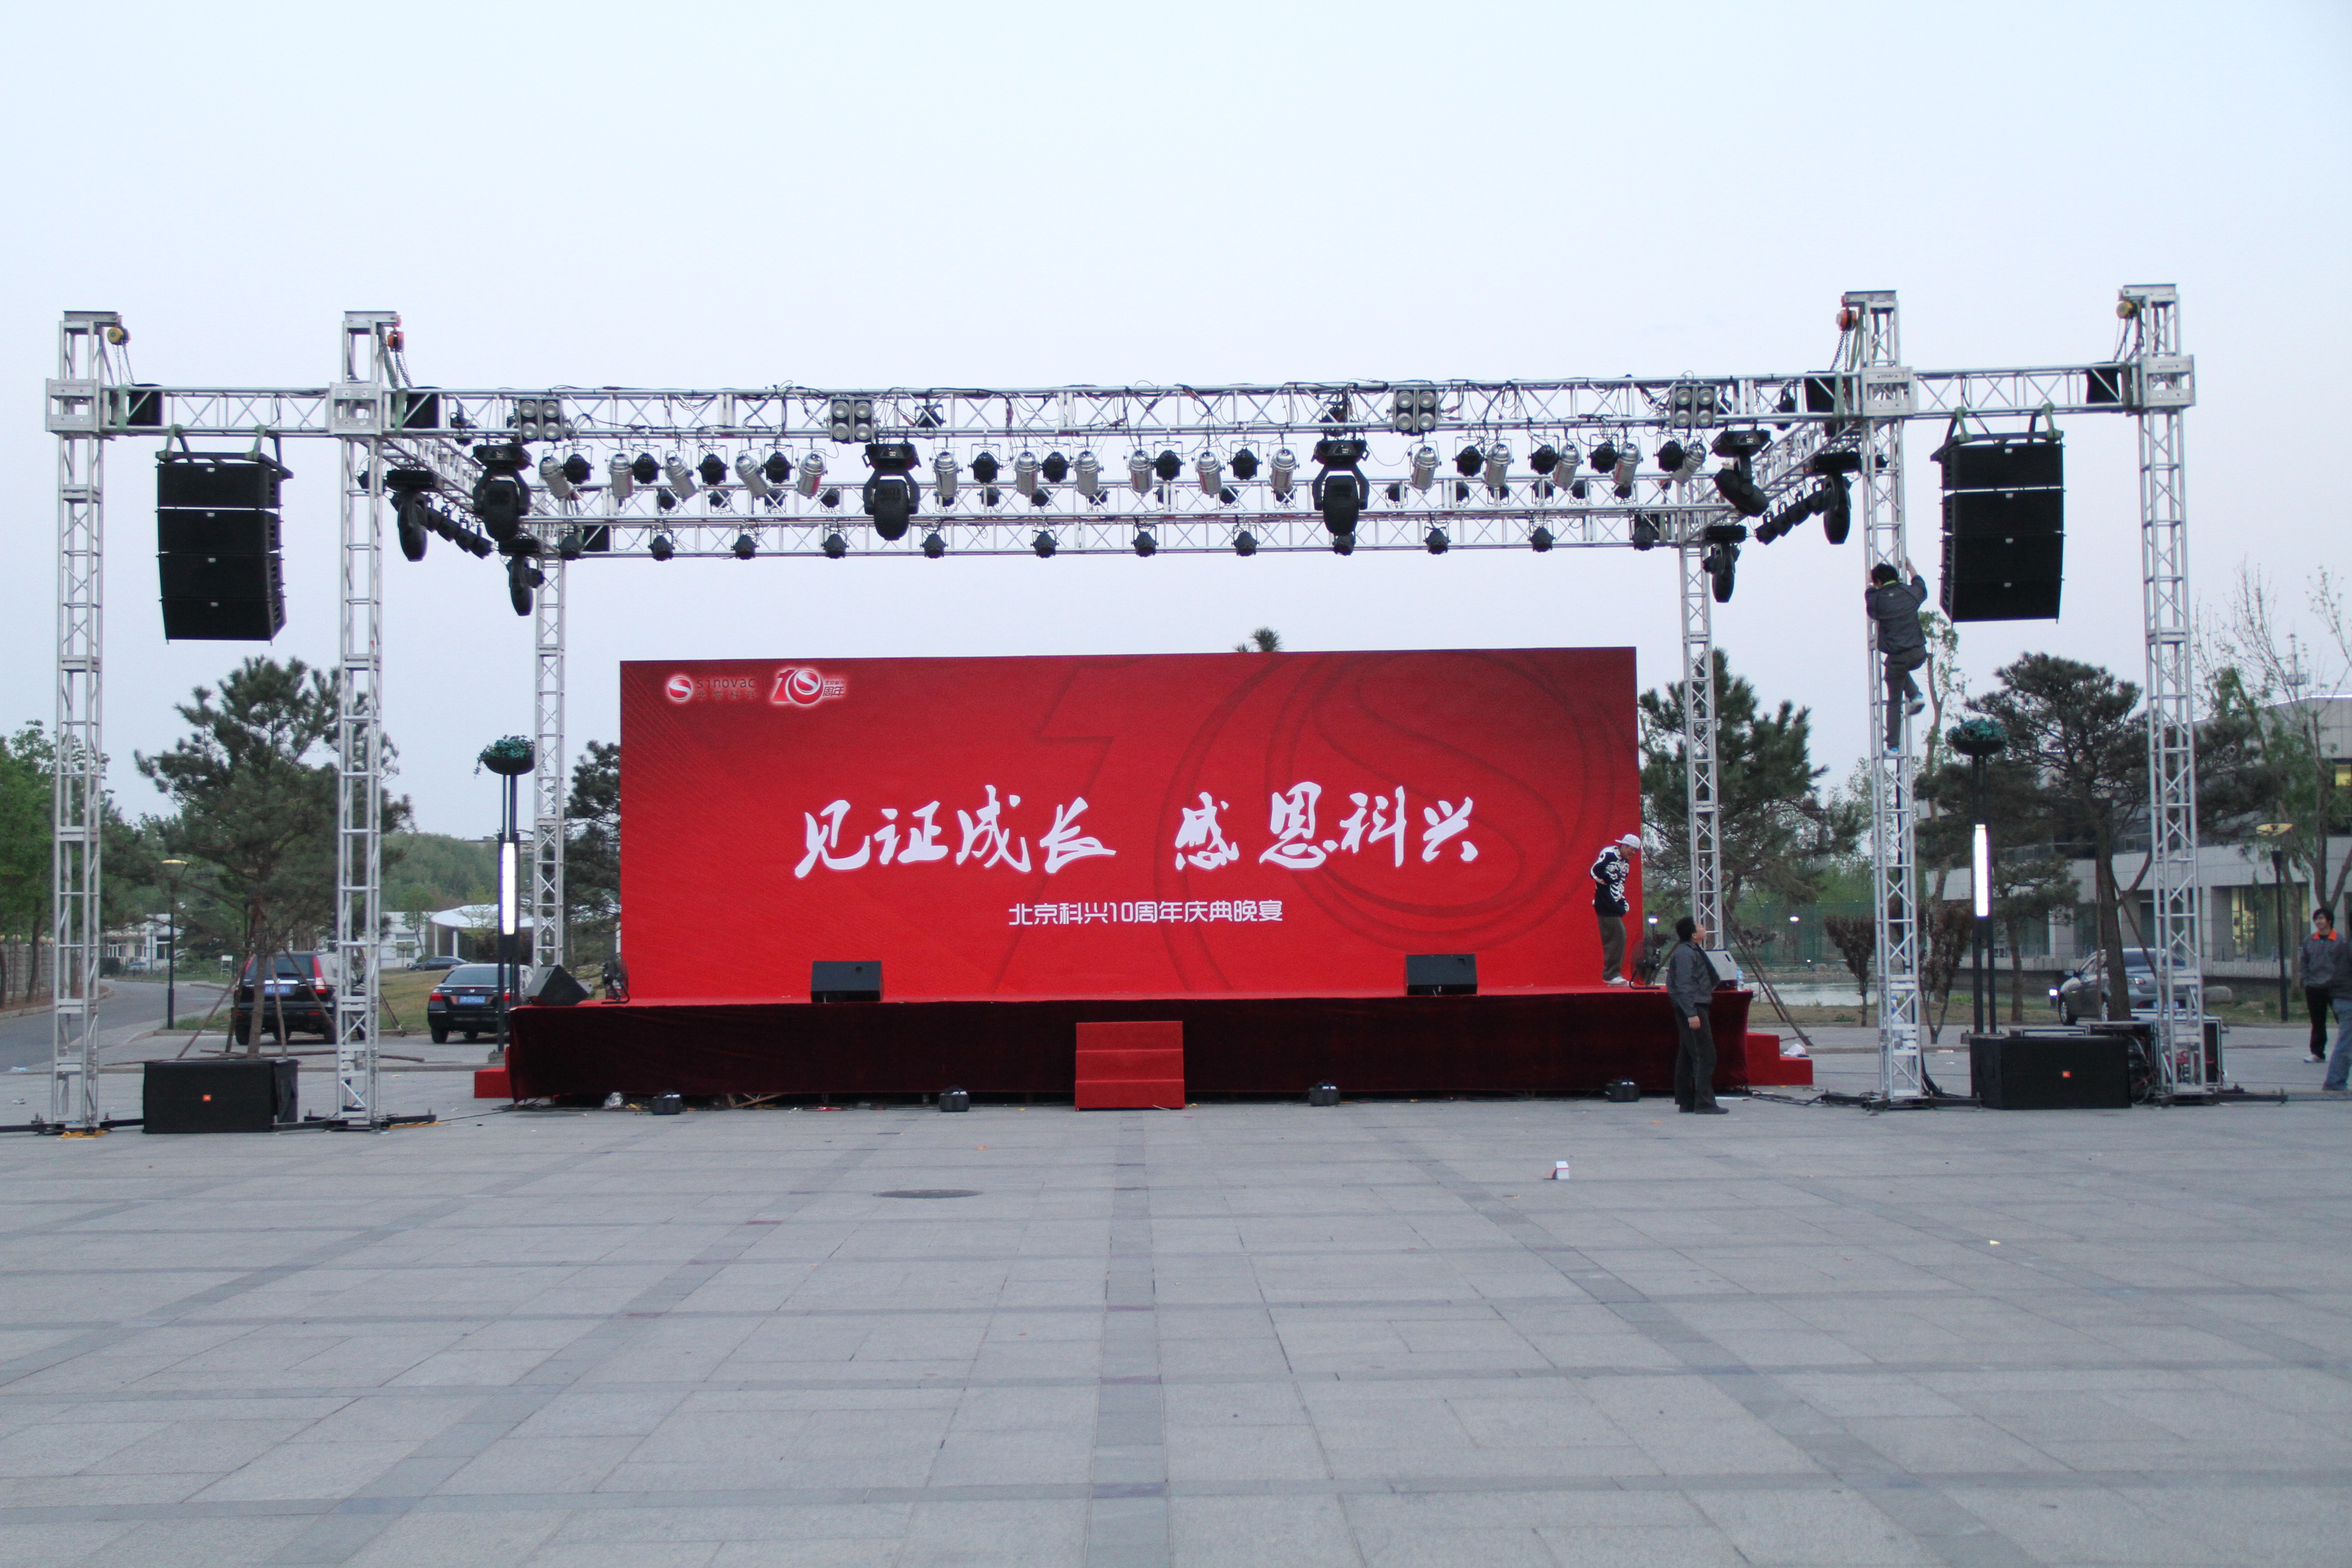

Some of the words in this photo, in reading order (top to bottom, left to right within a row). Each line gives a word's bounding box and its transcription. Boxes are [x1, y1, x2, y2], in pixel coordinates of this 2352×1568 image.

[696, 678, 755, 689] sinovac
[795, 785, 1116, 878] 见证成长
[1175, 782, 1478, 870] 感恩科兴
[1009, 900, 1282, 925] 北京科兴10周年庆典晚宴
